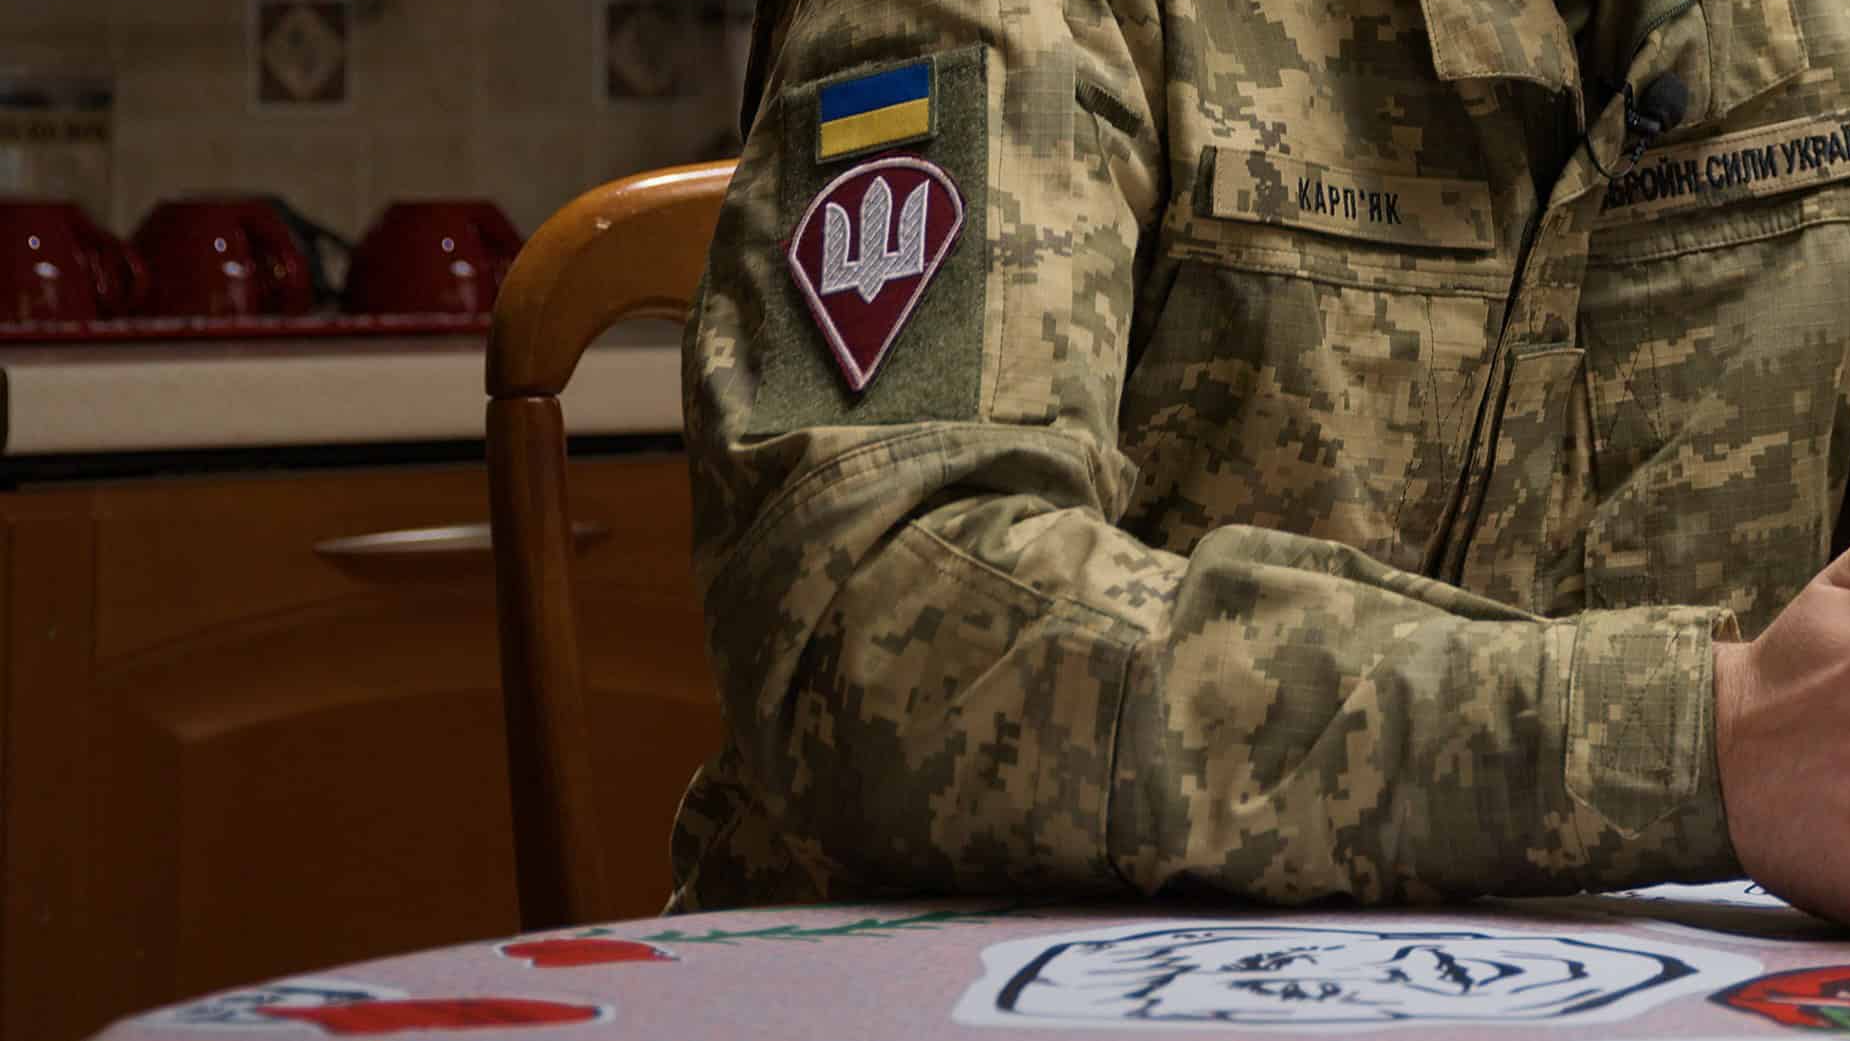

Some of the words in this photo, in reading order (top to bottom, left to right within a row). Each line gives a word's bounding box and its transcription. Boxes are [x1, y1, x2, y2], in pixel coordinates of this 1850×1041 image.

[1298, 176, 1402, 225] КАРП'ЯК
[1600, 157, 1698, 216] БРОЙНІ
[1704, 143, 1778, 188] СИЛИ
